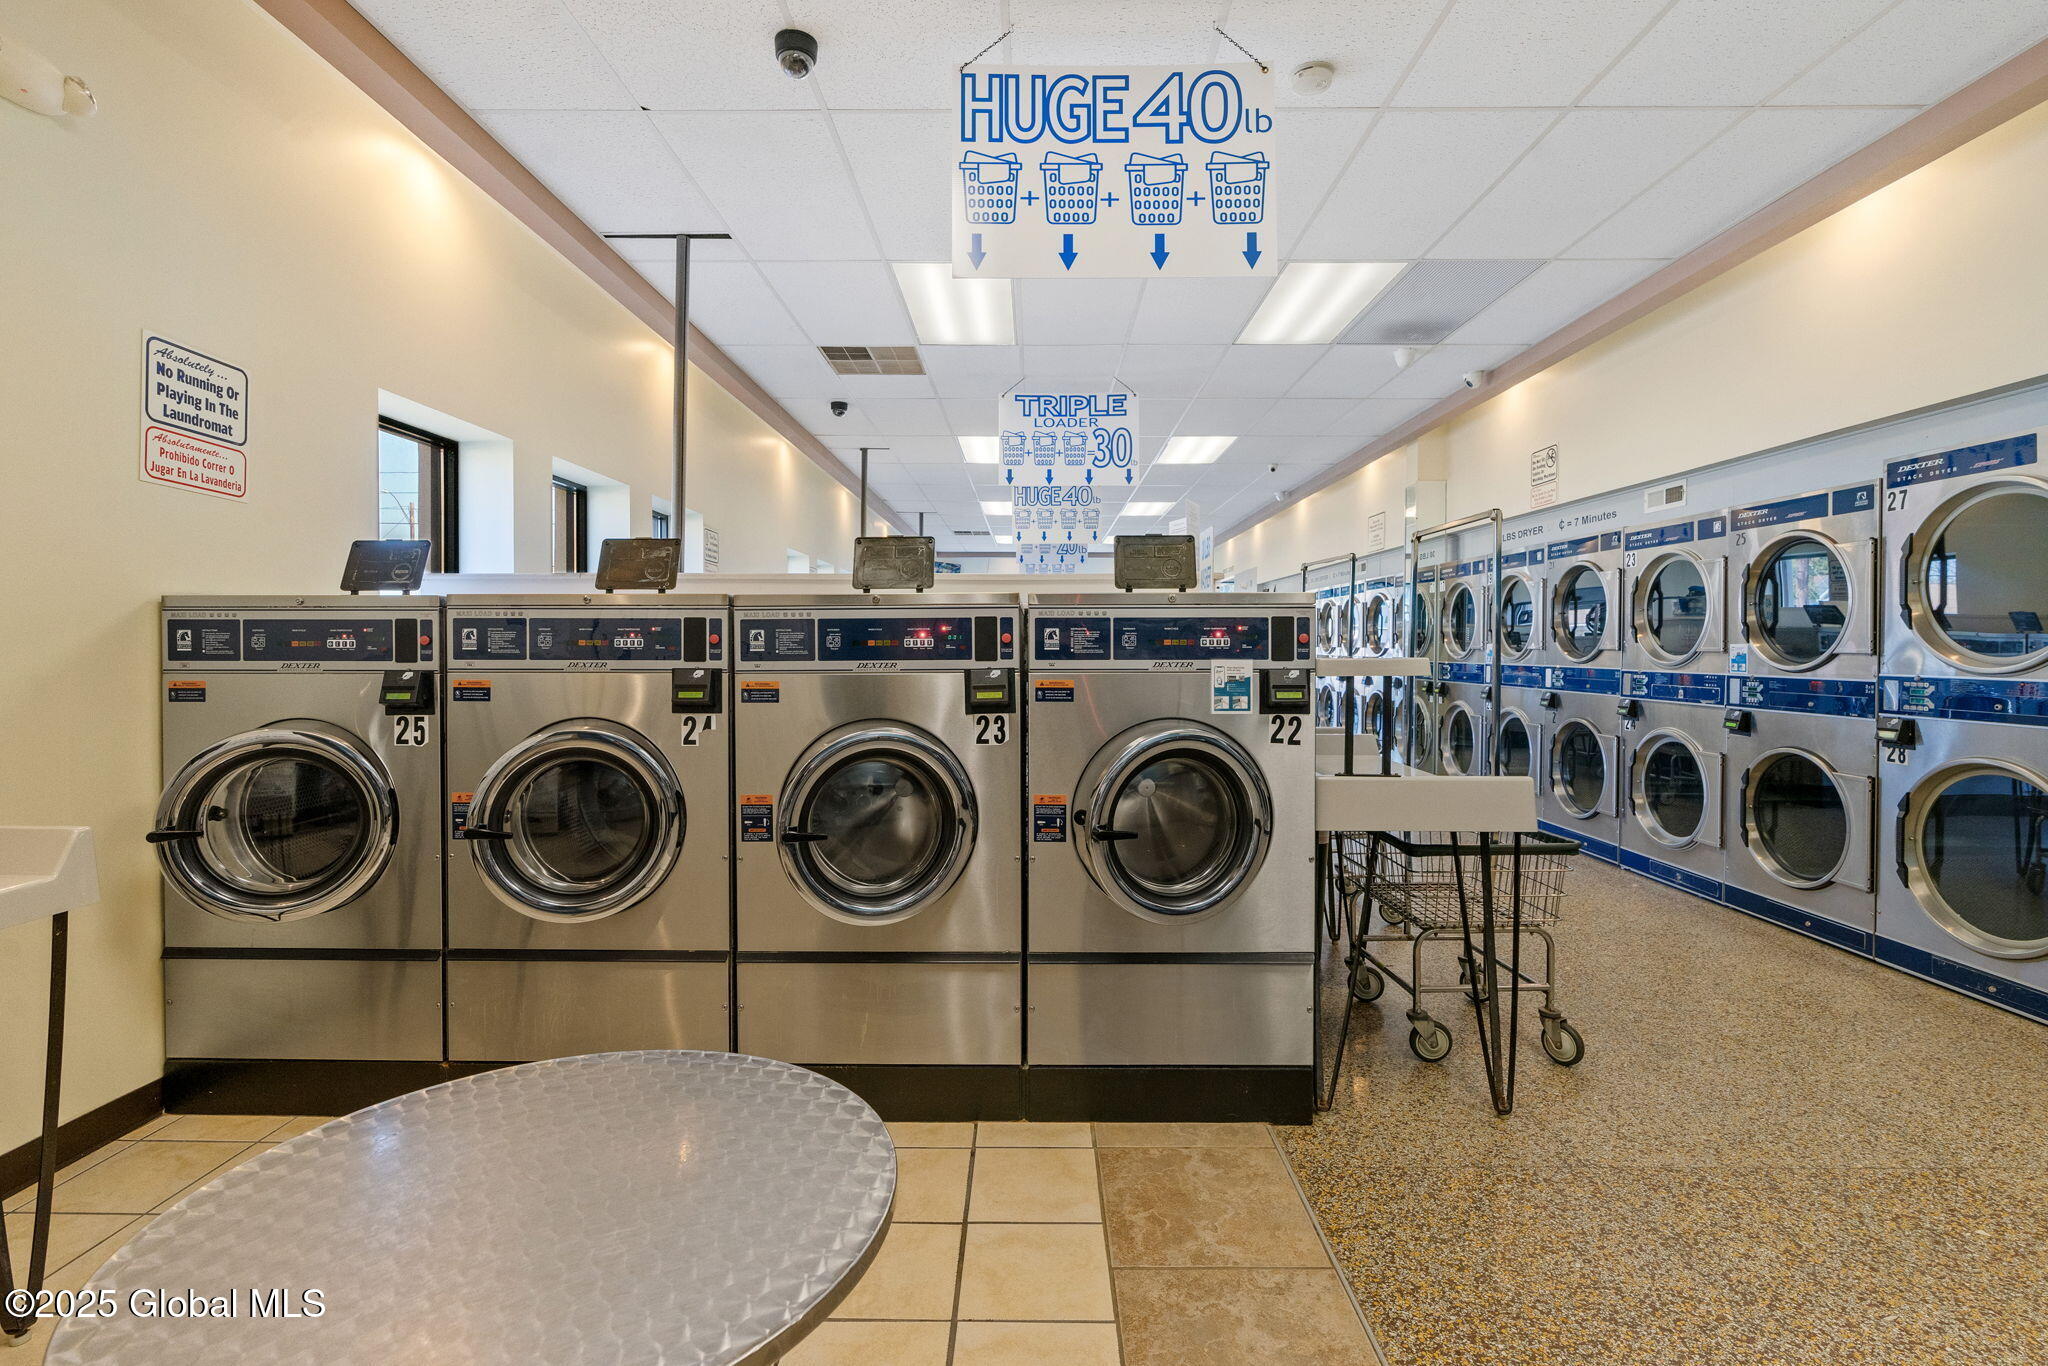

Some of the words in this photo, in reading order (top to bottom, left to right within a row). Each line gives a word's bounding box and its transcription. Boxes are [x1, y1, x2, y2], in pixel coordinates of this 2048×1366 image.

[960, 72, 1129, 144] HUGE
[154, 347, 215, 377] Absolutely
[156, 361, 173, 379] No
[176, 368, 223, 398] Running
[226, 386, 240, 401] Or
[156, 382, 202, 411] Playing
[205, 398, 216, 413] In
[219, 402, 239, 420] The
[1015, 394, 1127, 417] TRIPLE
[163, 404, 233, 437] Laundromat
[1034, 417, 1099, 428] LOADER
[159, 446, 200, 467] Prohibido
[202, 458, 227, 474] Correr
[229, 465, 235, 476] O
[1897, 458, 1944, 473] DEXTER
[1930, 466, 1958, 477] DRYER
[150, 460, 175, 477] Jugar
[177, 467, 187, 479] En
[189, 470, 199, 482] La
[201, 473, 242, 492] Lavanderia
[1014, 485, 1061, 507] HUGE
[1887, 489, 1908, 512] 27
[1503, 530, 1516, 543] LBS
[1518, 525, 1544, 539] DRYER
[1575, 517, 1579, 527] 7
[1581, 510, 1617, 526] Minutes
[1736, 532, 1746, 546] 25
[1626, 553, 1636, 567] 23
[396, 716, 426, 746] 25
[975, 715, 1006, 744] 23
[1270, 715, 1302, 745] 22
[1886, 748, 1906, 764] 28
